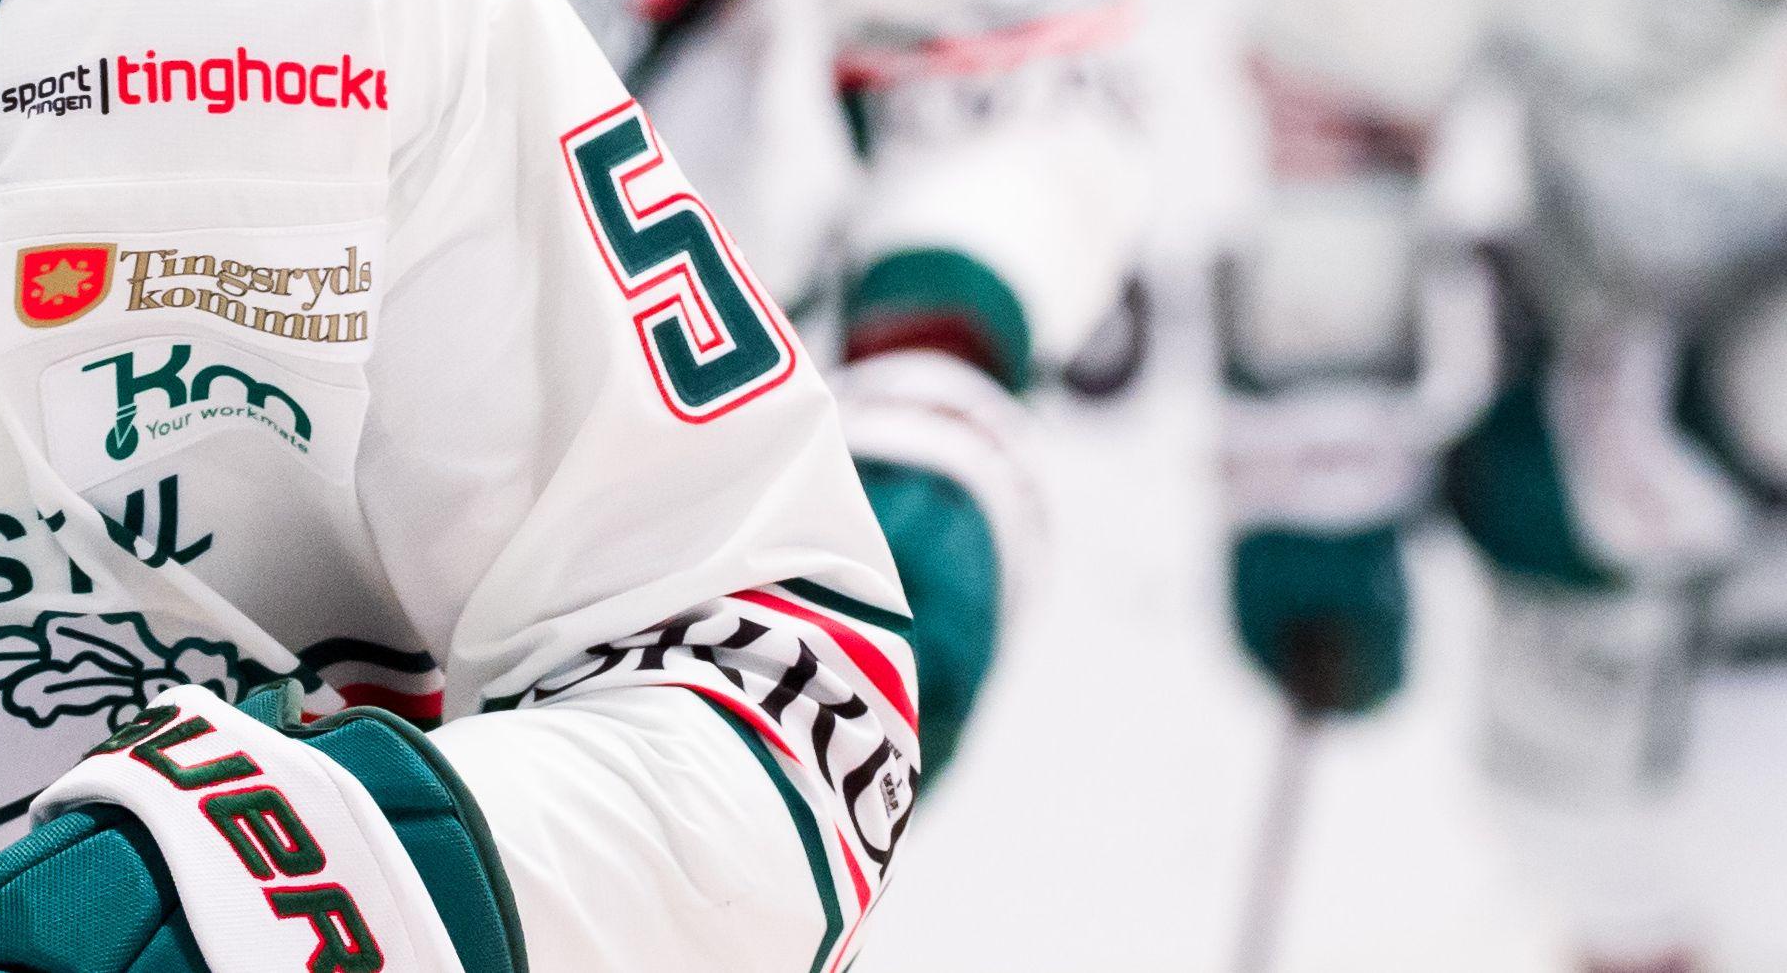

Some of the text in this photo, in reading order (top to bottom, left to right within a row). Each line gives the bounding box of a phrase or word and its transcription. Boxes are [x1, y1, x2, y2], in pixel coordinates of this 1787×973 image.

[1, 64, 91, 114] sport
[120, 246, 372, 311] Tingsryds
[560, 96, 796, 424] 5
[125, 278, 369, 343] kommun
[146, 405, 310, 455] Your workmate
